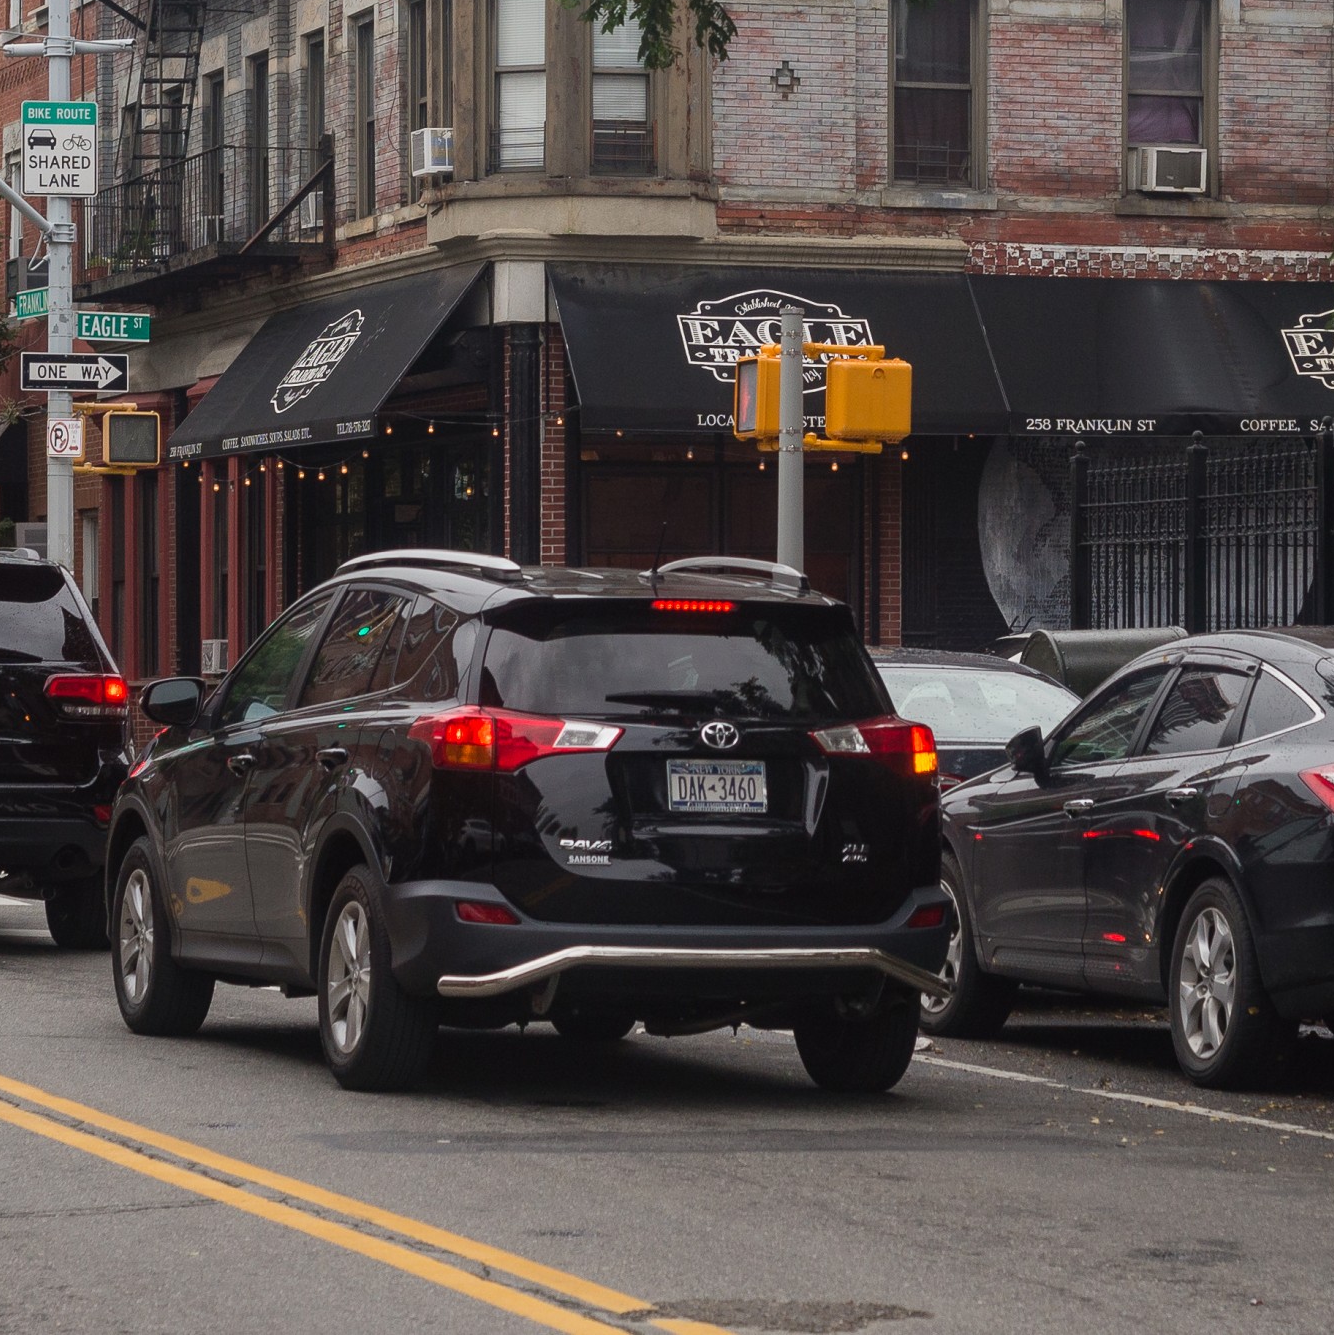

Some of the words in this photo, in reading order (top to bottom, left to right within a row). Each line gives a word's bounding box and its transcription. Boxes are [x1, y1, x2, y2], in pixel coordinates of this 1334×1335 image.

[28, 107, 51, 119] BIKE
[56, 108, 91, 119] ROUTE
[28, 155, 91, 169] SHARED
[39, 173, 80, 187] LANE
[735, 297, 782, 315] Established
[82, 315, 128, 337] EAGLE
[133, 317, 143, 329] ST
[293, 336, 356, 367] EAGLE
[37, 365, 67, 379] ONE
[81, 366, 112, 380] WAY
[697, 414, 735, 426] LOCA
[1026, 418, 1052, 430] 258
[1056, 418, 1132, 434] FRANKLIN
[1137, 419, 1157, 432] ST
[1240, 419, 1301, 433] COFFEE,
[693, 765, 714, 774] NEW
[717, 765, 741, 774] YORK
[678, 776, 707, 800] DAK
[718, 776, 756, 801] 3460
[559, 839, 613, 852] RAV4
[569, 855, 609, 863] SANSONE
